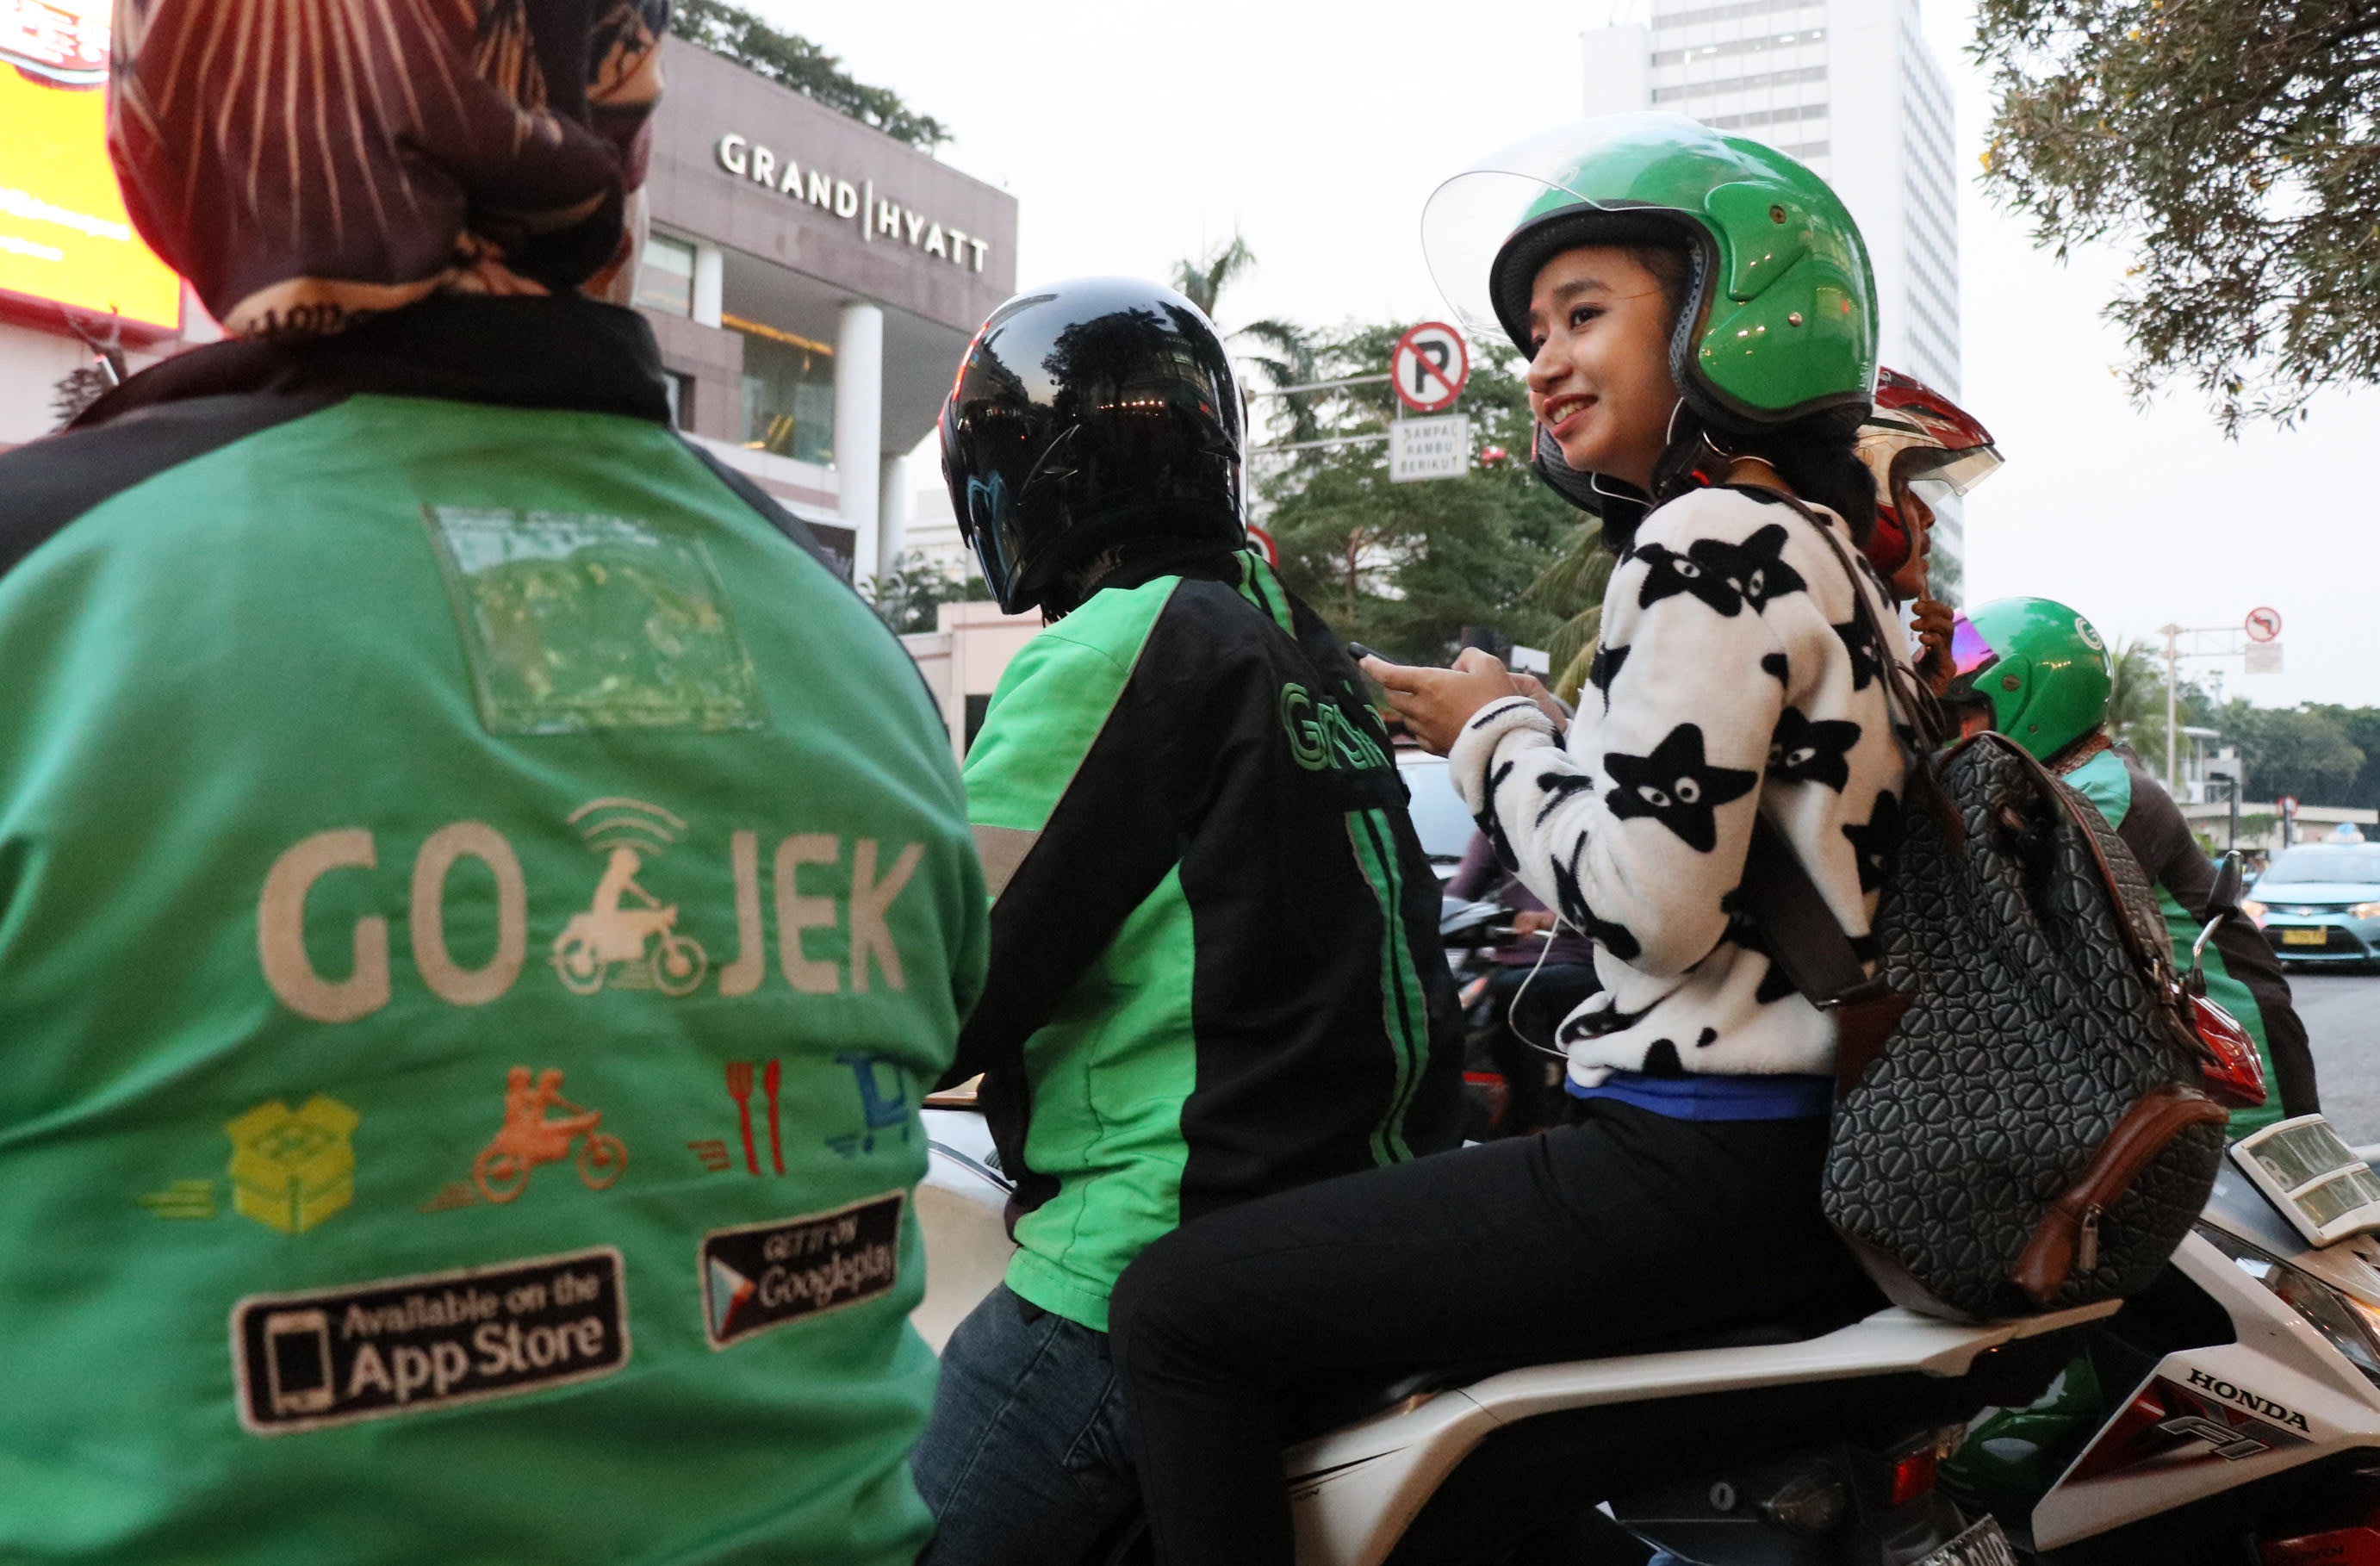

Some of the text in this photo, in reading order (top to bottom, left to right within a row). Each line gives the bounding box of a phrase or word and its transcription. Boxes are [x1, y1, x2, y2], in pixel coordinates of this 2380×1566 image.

[719, 133, 989, 273] GRAND HYATT
[1407, 440, 1453, 455] RAMBU
[260, 823, 925, 1021] GO JEK
[345, 1271, 600, 1337] Available on the
[346, 1314, 603, 1402] App Store
[2186, 1368, 2310, 1432] HONDA
